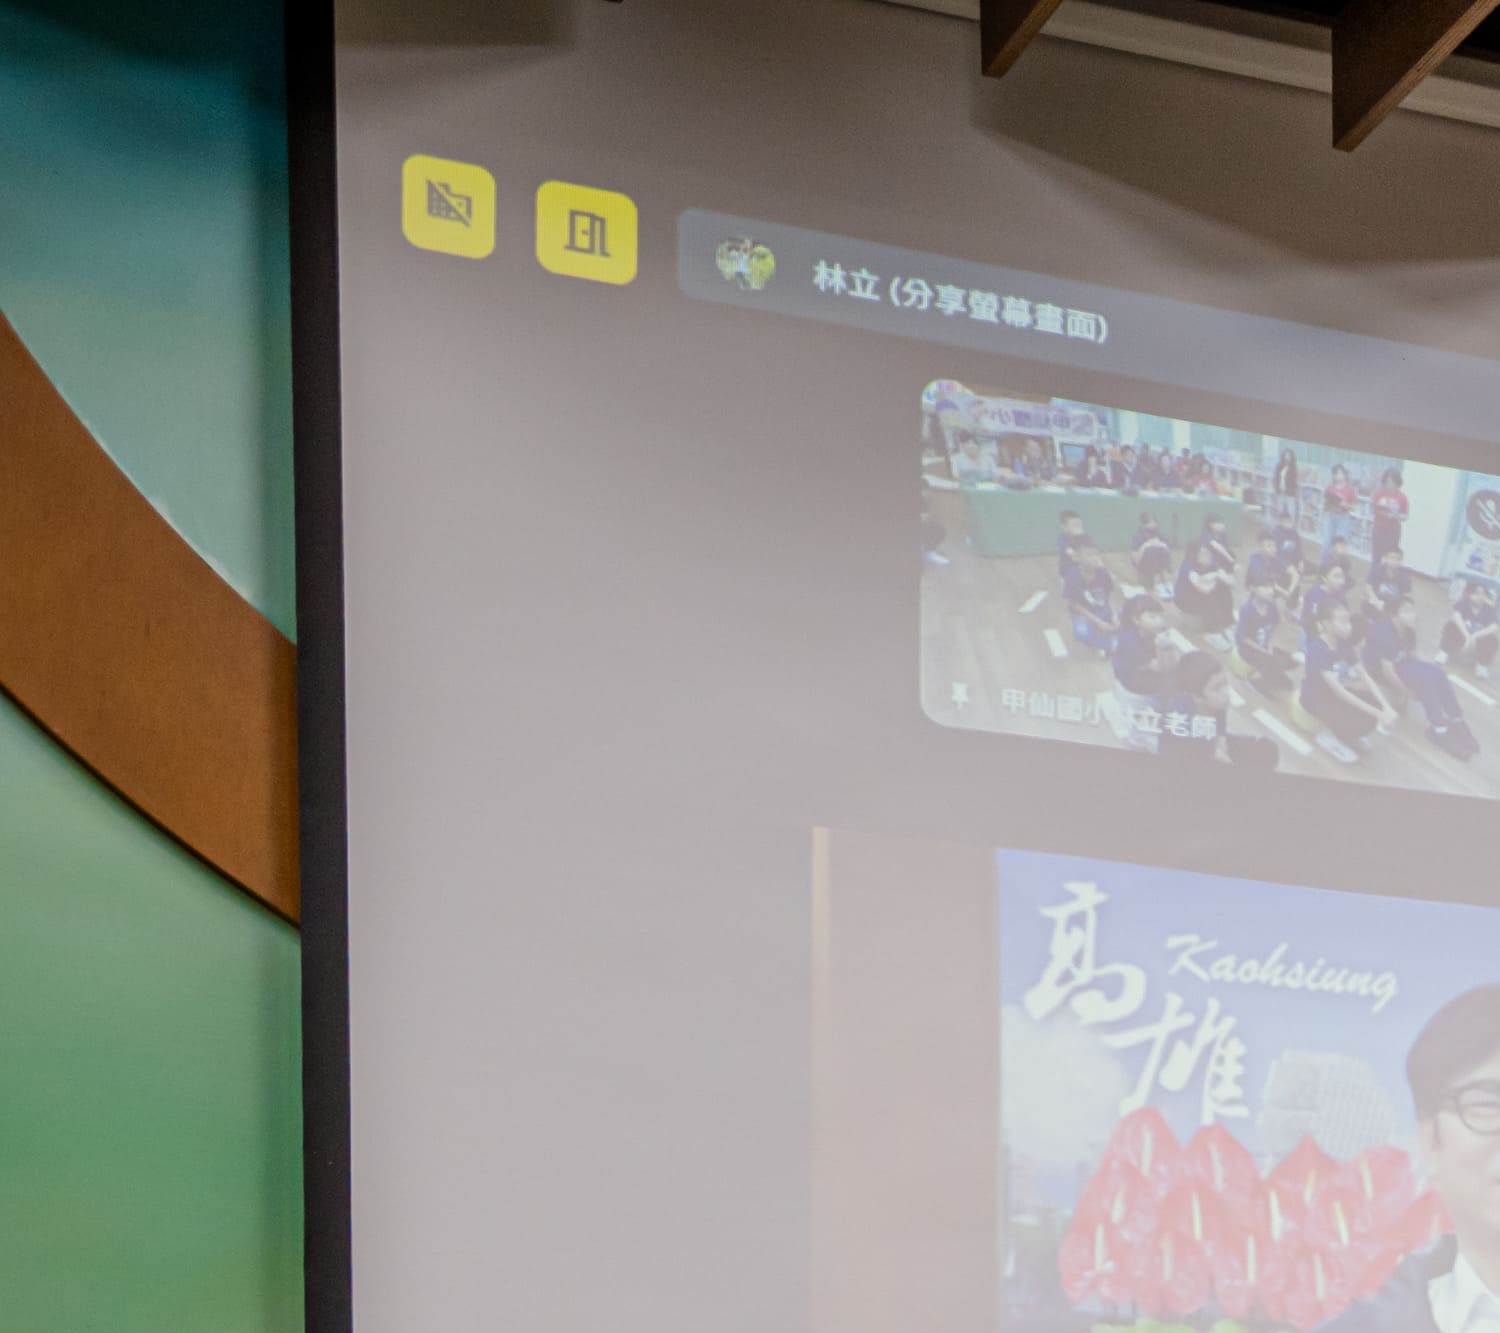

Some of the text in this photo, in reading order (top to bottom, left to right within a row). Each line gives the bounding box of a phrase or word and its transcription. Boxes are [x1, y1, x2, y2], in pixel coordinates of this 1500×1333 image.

[813, 258, 1110, 345] 林立 (分享螢幕畫面)
[1163, 933, 1399, 1014] Kaohsiung
